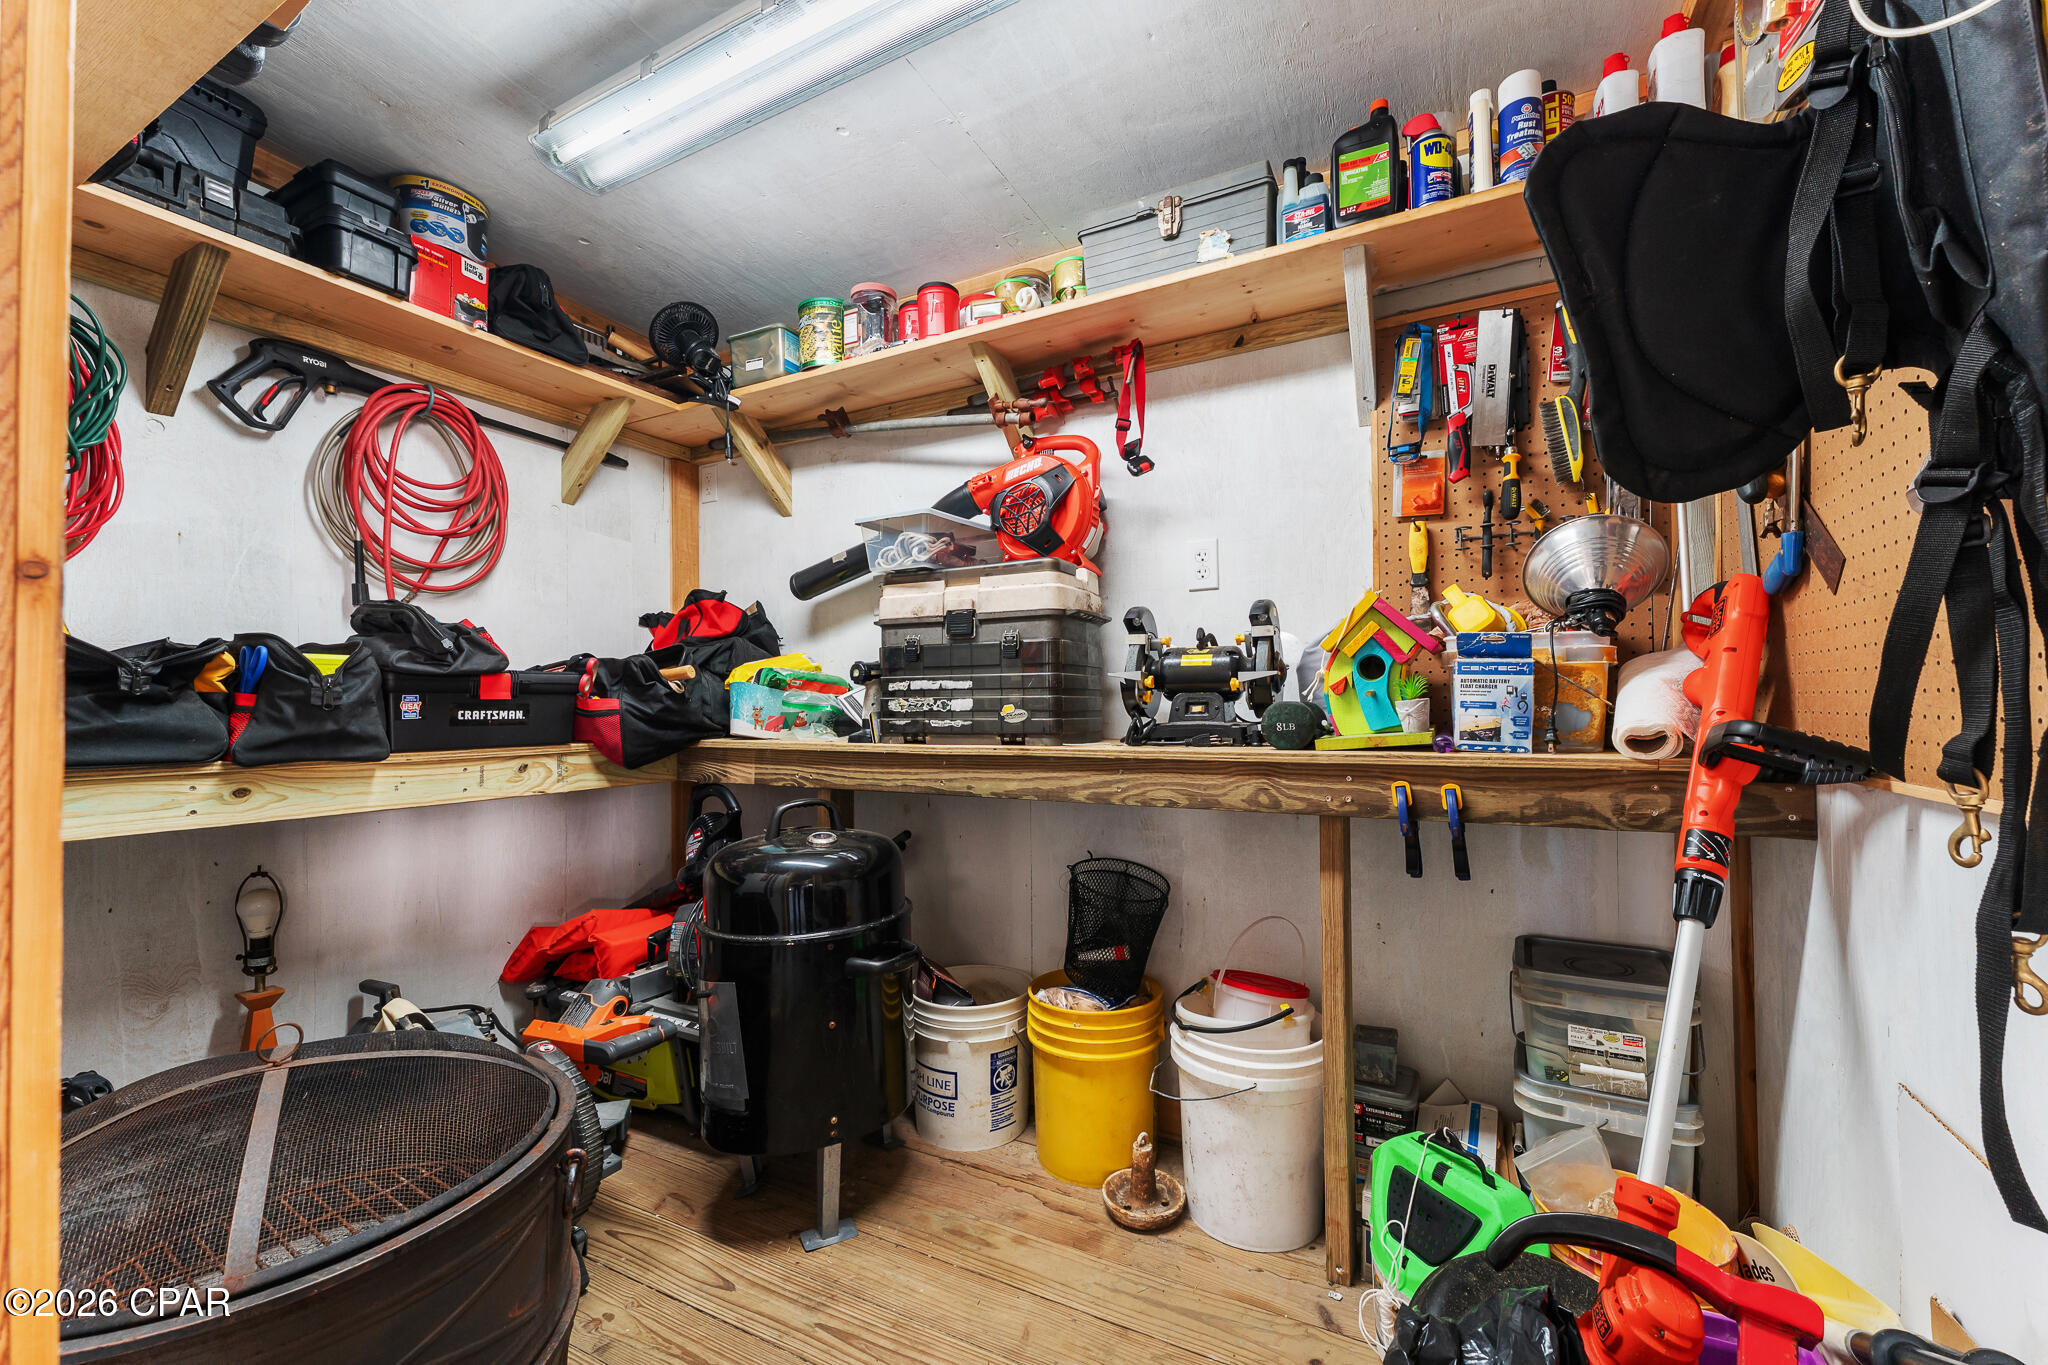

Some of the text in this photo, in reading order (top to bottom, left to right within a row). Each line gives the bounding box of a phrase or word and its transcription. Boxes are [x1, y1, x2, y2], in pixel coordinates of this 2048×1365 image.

[1518, 120, 1536, 130] Rust
[1545, 94, 1560, 143] UEL
[302, 355, 327, 369] RYOBI
[402, 702, 419, 711] USA
[926, 1075, 952, 1092] LINE
